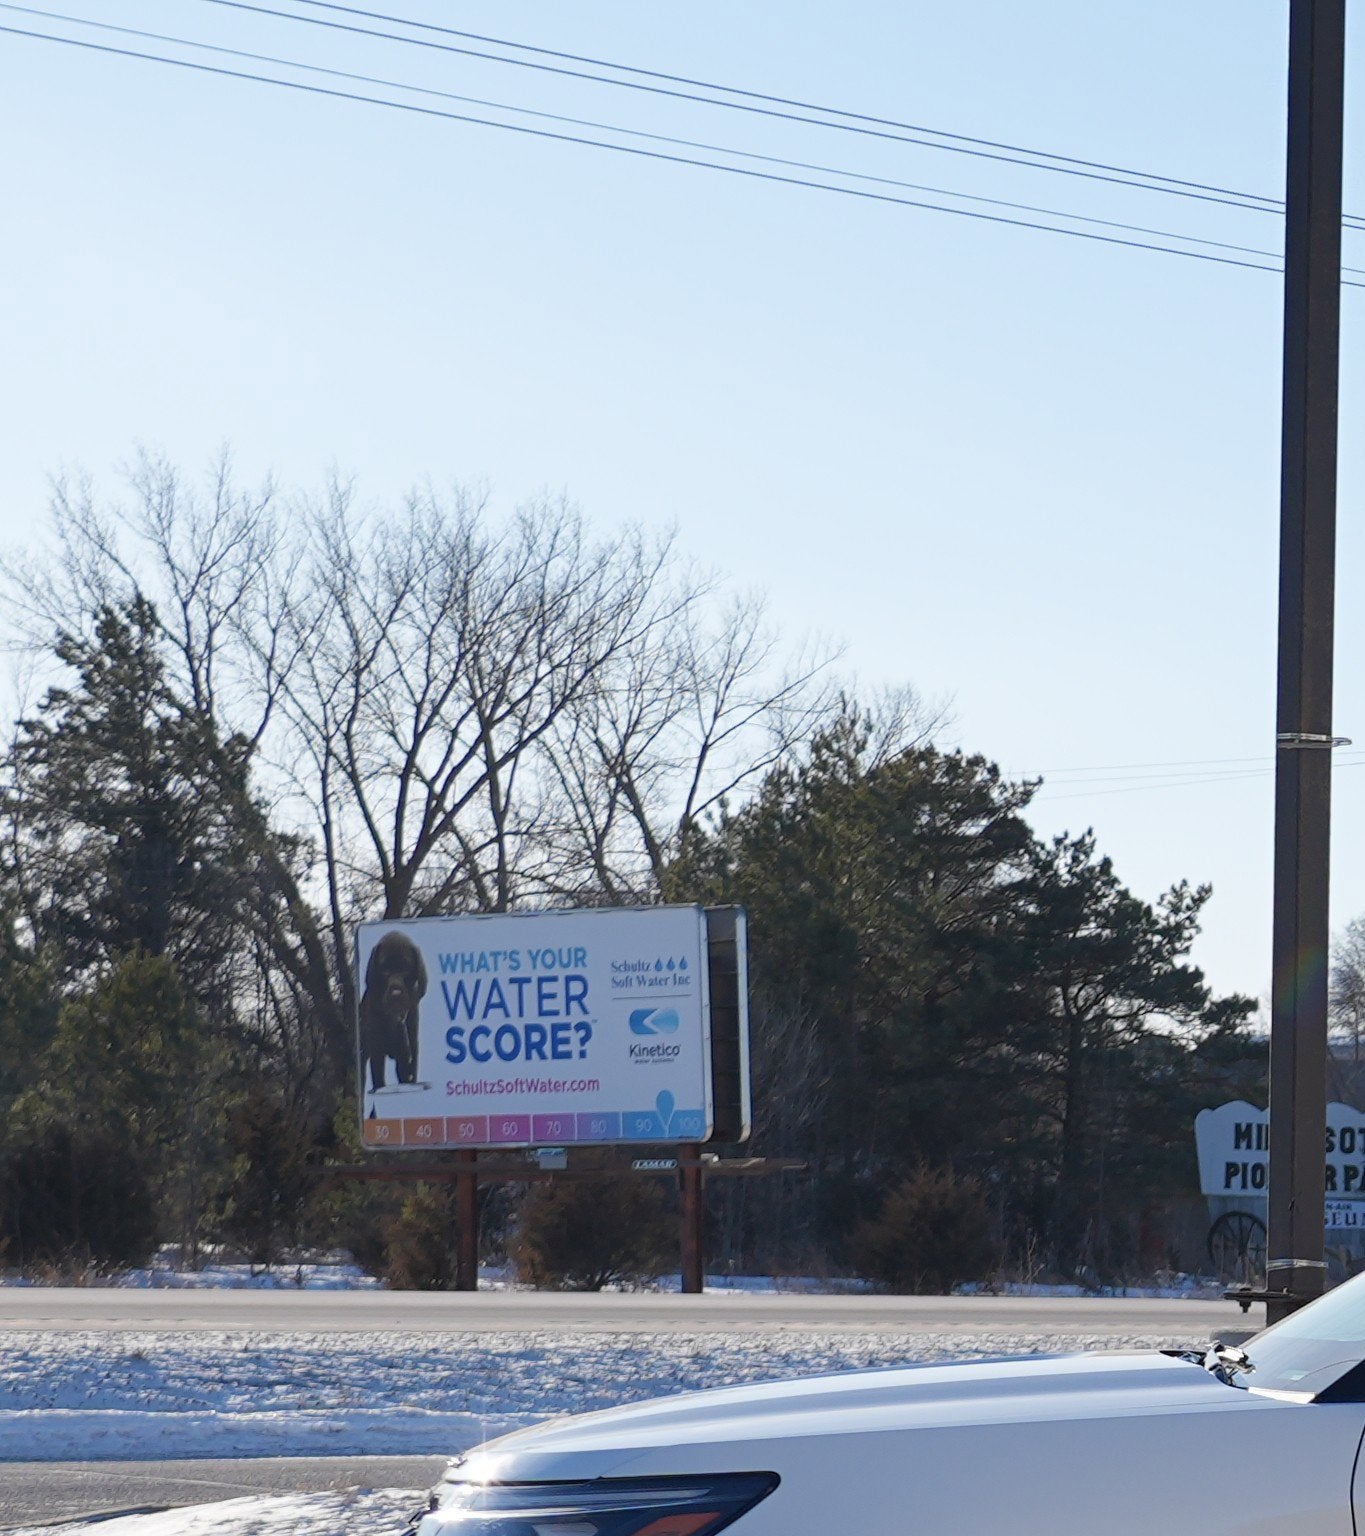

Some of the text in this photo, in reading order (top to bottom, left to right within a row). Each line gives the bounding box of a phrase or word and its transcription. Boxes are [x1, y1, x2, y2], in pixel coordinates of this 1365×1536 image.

[438, 947, 588, 974] WHAT'S YOUR
[611, 959, 652, 972] Schultz
[611, 976, 633, 988] Soft
[636, 975, 671, 987] Water
[440, 974, 590, 1021] WATER
[445, 1020, 593, 1064] SCORE?
[629, 1042, 680, 1058] Kinetico
[446, 1077, 600, 1096] SchultzSoftWater.com
[375, 1116, 700, 1140] 30 40 50 60 70 80 90 100
[1224, 1162, 1337, 1192] PIOR
